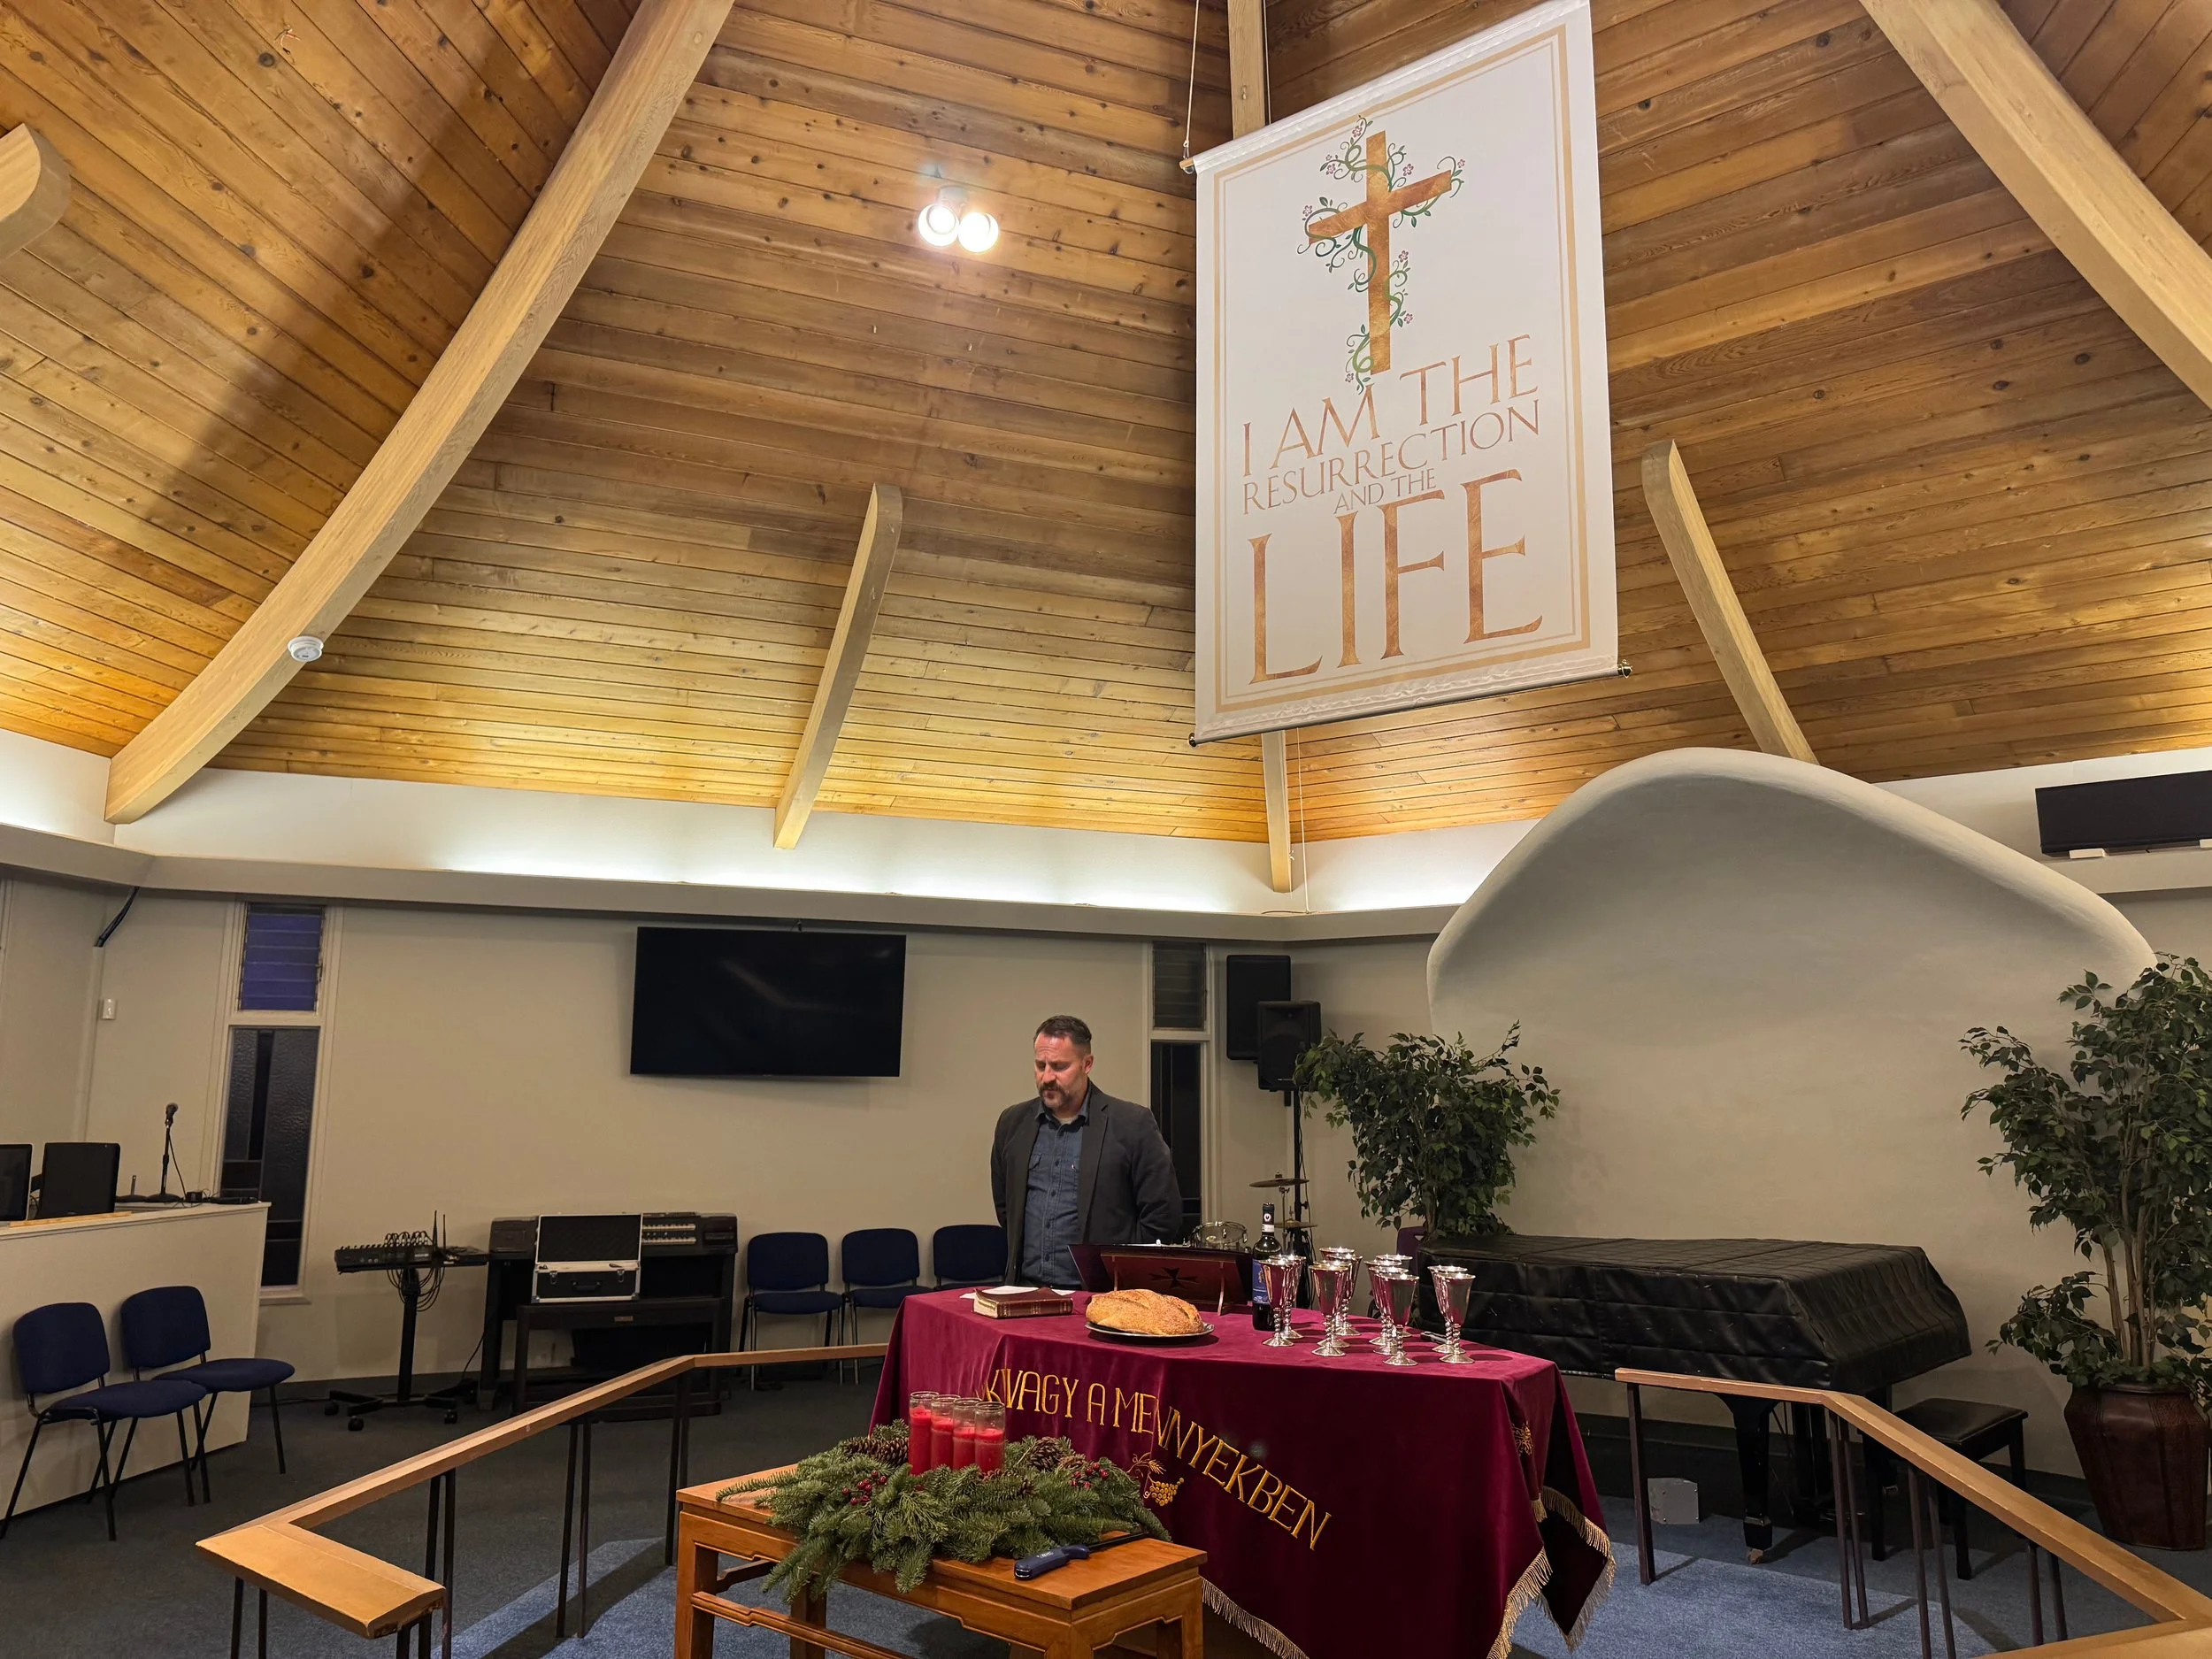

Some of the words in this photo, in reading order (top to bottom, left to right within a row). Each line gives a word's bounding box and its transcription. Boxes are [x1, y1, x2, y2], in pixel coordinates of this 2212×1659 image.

[1242, 422, 1251, 477] I
[1270, 383, 1380, 469] AM
[1399, 334, 1539, 426] THE
[1243, 399, 1540, 515] RESURRECTION
[1333, 481, 1384, 514] AND
[1391, 468, 1437, 497] THE
[1247, 468, 1543, 685] LIFE
[1087, 1382, 1105, 1425] A
[1113, 1387, 1332, 1551] MENNYEKBEN
